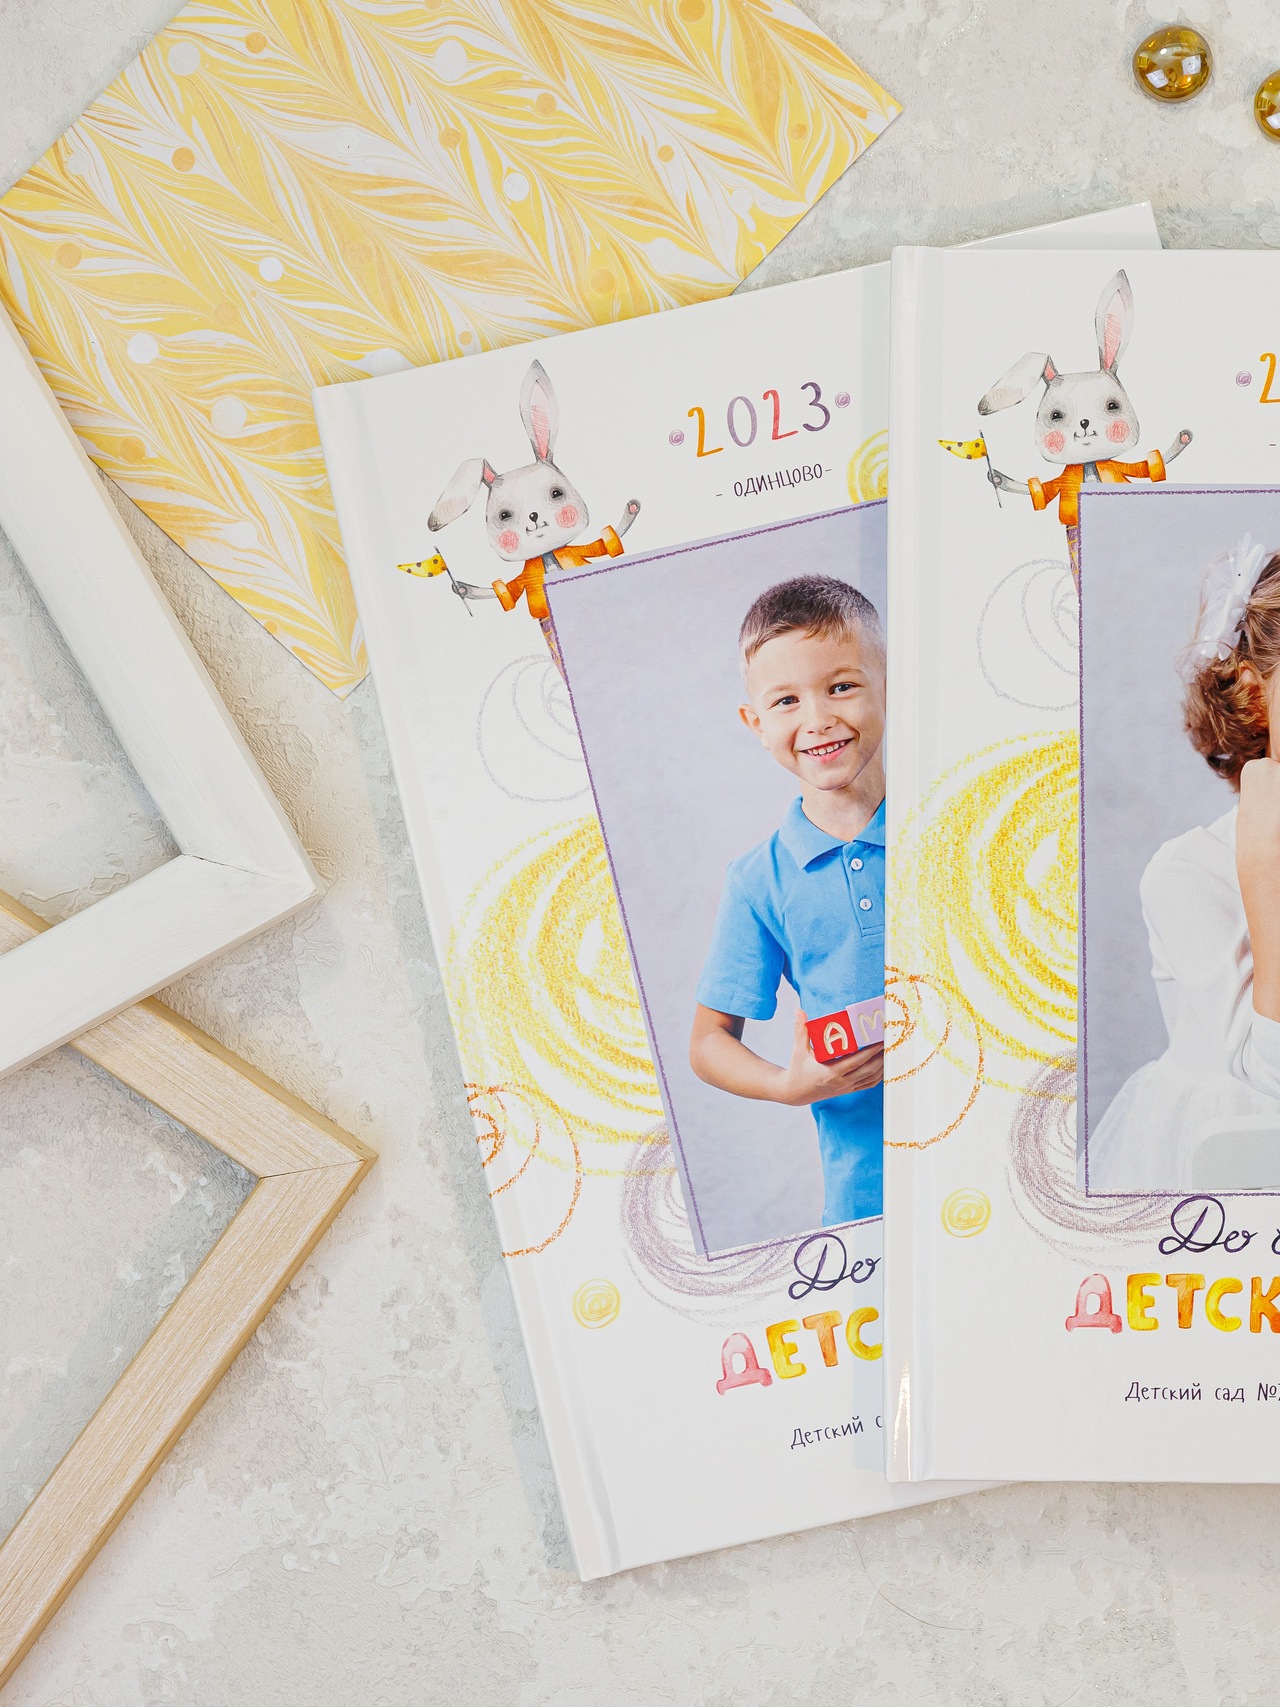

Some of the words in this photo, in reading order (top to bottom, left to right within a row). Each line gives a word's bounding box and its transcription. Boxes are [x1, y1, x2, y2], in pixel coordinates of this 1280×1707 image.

[687, 382, 831, 457] 2023
[1158, 1194, 1258, 1256] До
[788, 1233, 882, 1300] До
[1124, 1381, 1202, 1403] Детский
[1214, 1387, 1245, 1403] сад
[790, 1415, 864, 1450] Детский
